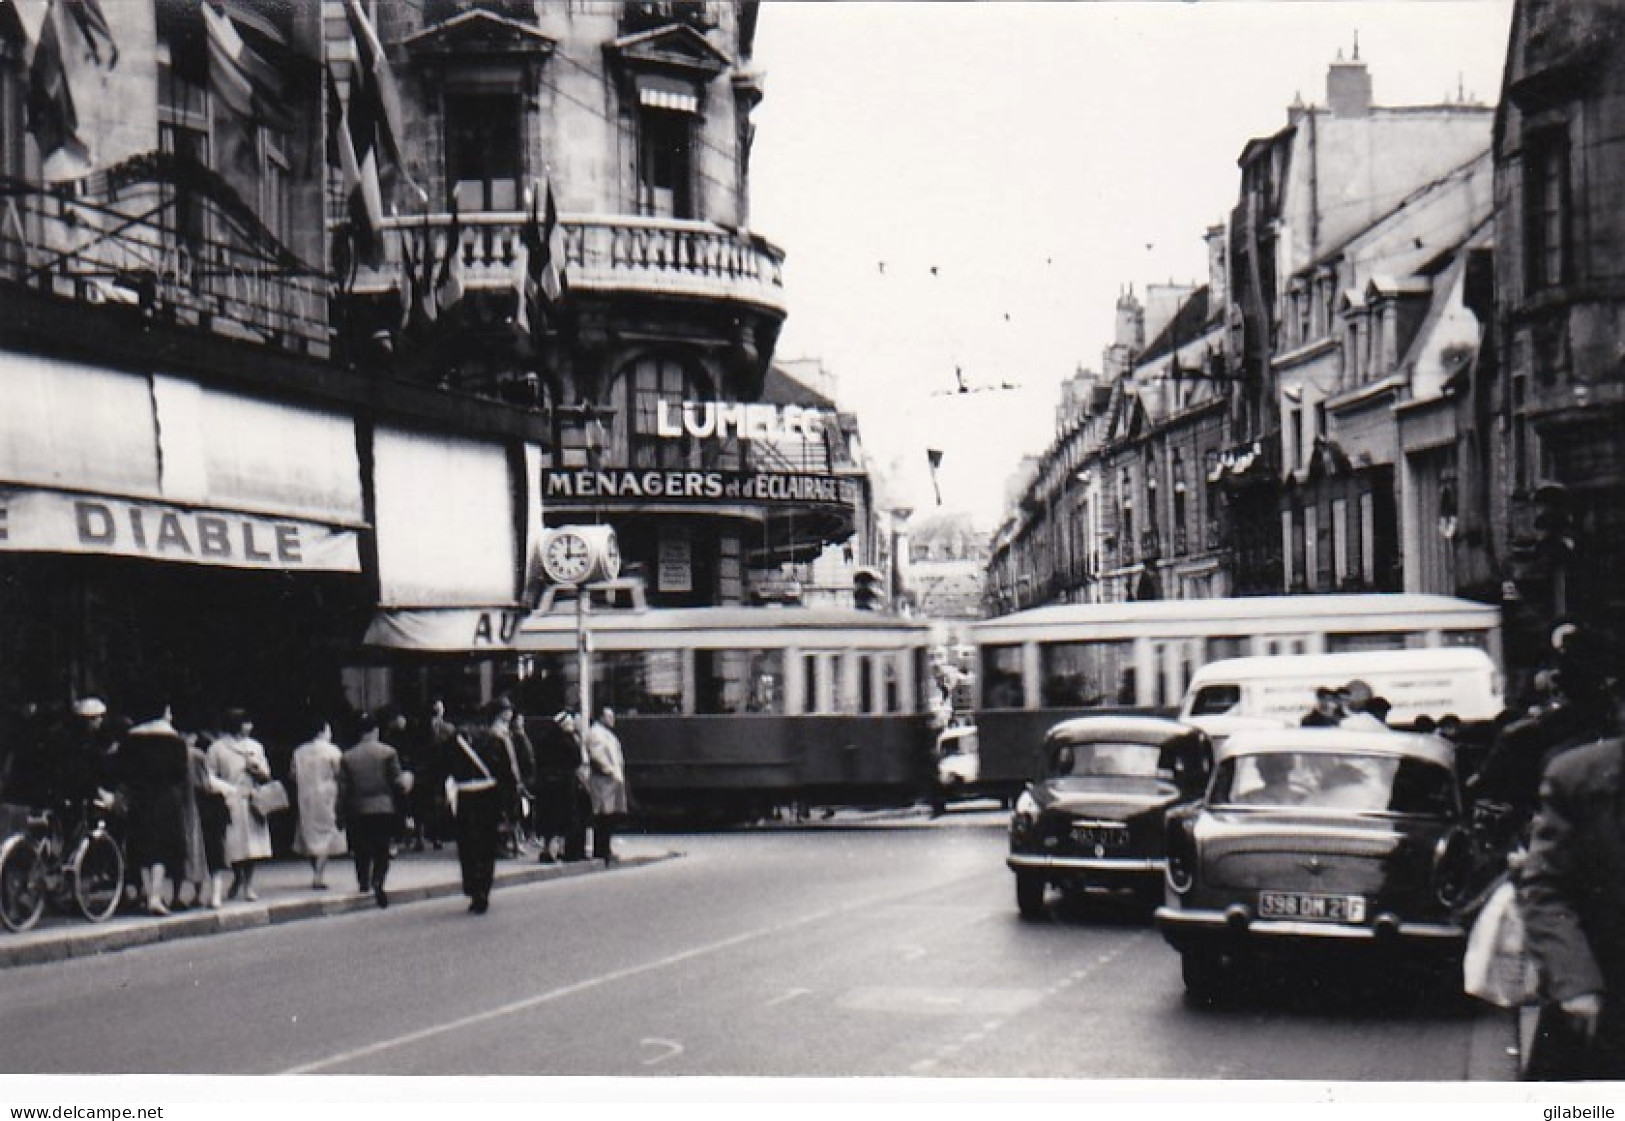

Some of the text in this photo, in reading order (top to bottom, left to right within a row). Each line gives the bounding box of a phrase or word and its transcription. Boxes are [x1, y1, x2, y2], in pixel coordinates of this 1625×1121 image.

[547, 469, 722, 497] MÉNAGERS
[74, 500, 303, 562] DIABLE
[473, 612, 517, 646] AU
